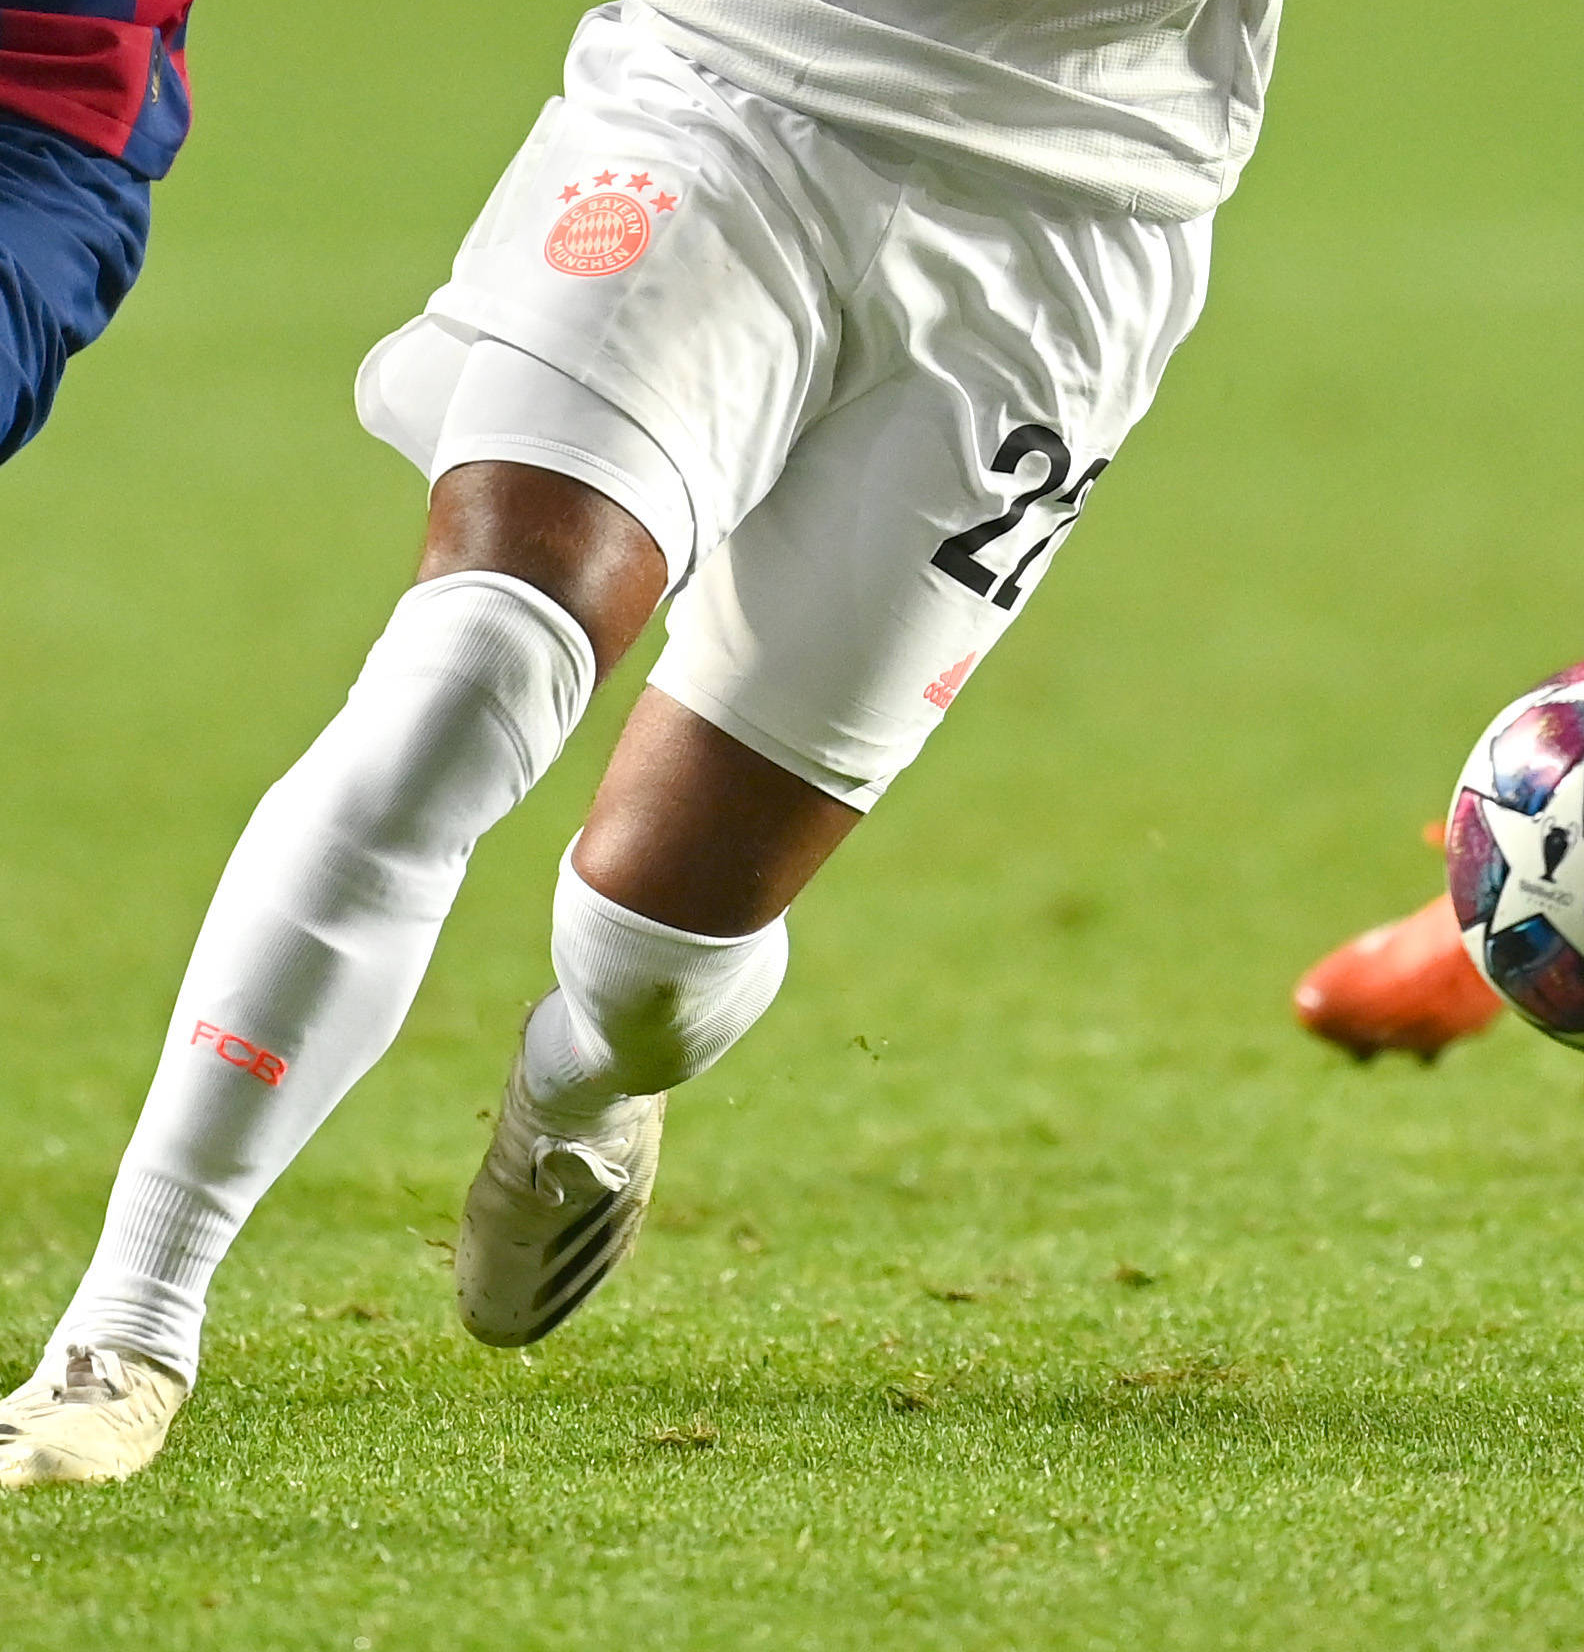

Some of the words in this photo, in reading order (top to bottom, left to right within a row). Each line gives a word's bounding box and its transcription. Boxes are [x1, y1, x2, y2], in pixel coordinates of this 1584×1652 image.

[561, 209, 583, 226] FC
[588, 199, 641, 234] BAYERN
[190, 1019, 287, 1086] FCB
